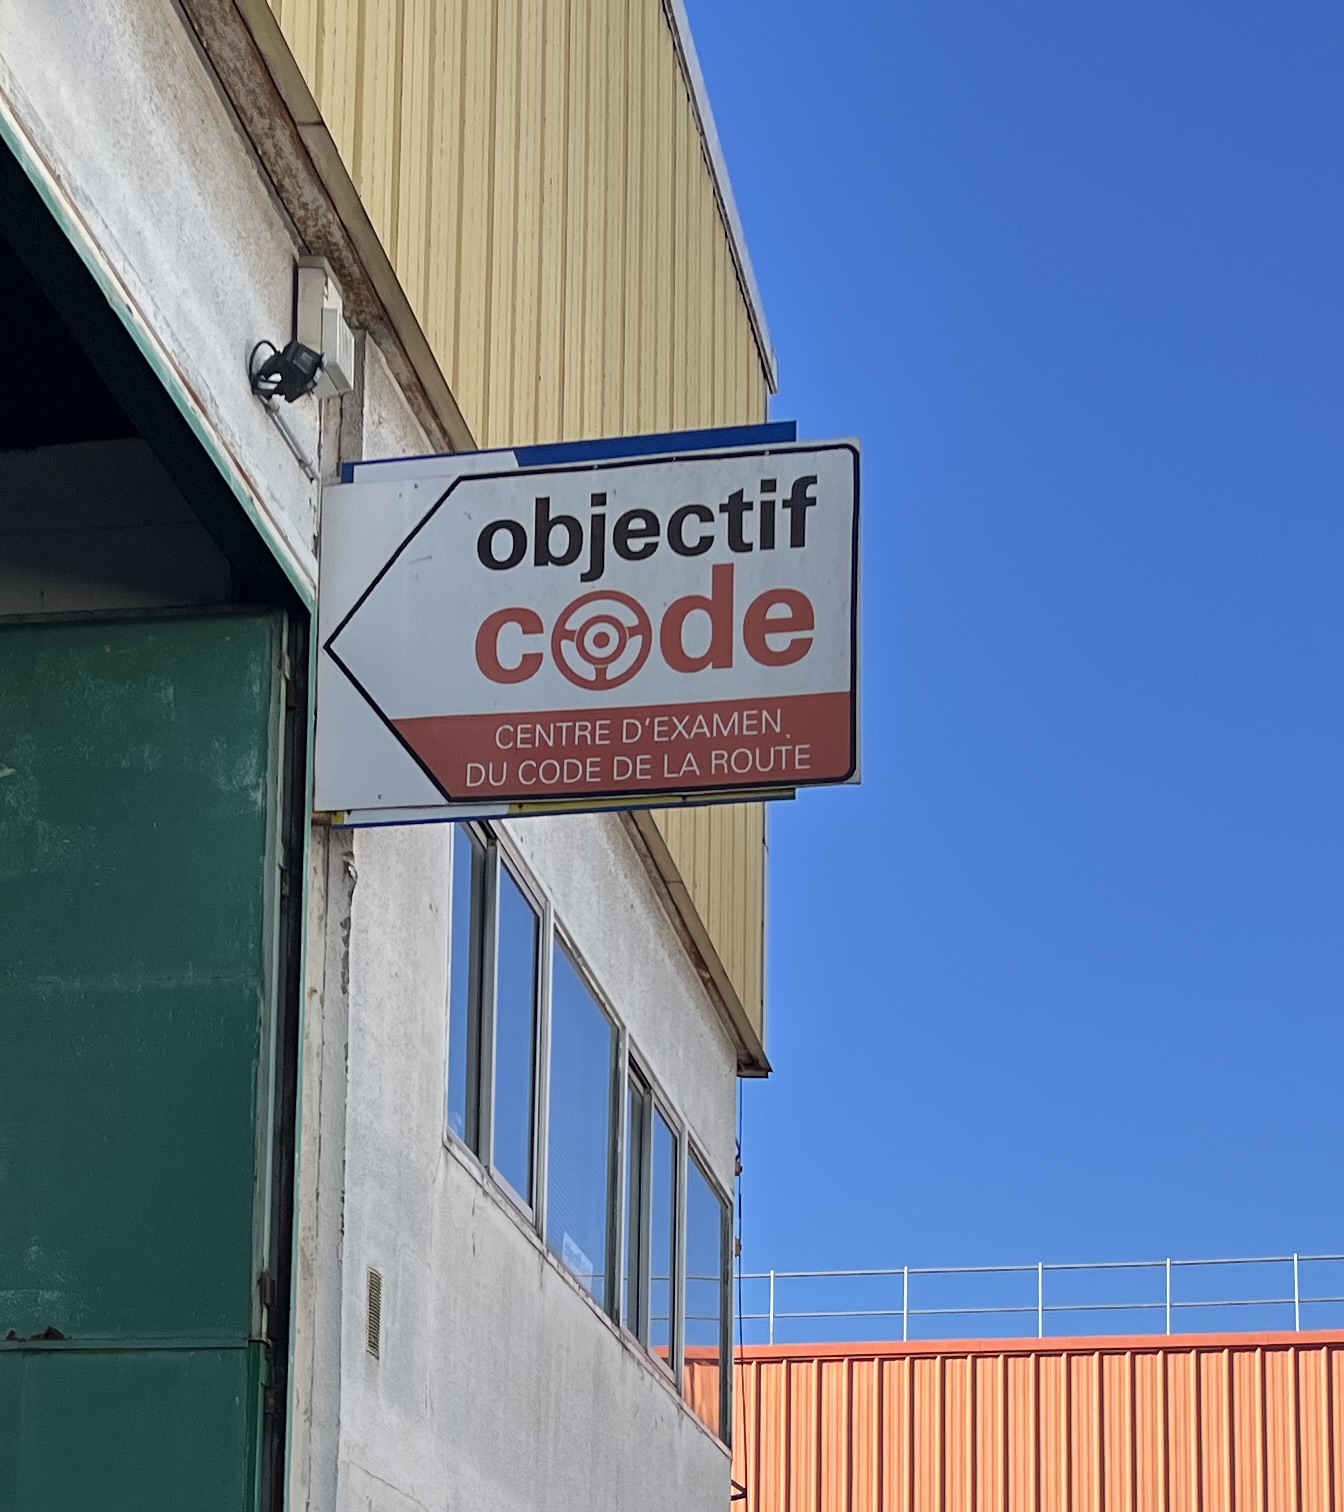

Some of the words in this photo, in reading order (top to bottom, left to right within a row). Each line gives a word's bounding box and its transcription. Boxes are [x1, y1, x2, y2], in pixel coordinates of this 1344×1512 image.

[476, 474, 818, 583] objectif
[495, 719, 611, 750] CENTRE
[621, 708, 783, 743] D'EXAMEN
[465, 760, 508, 788] DU
[517, 756, 603, 785] CODE
[612, 753, 652, 781] DE
[662, 751, 700, 779] LA
[711, 744, 812, 775] ROUTE
